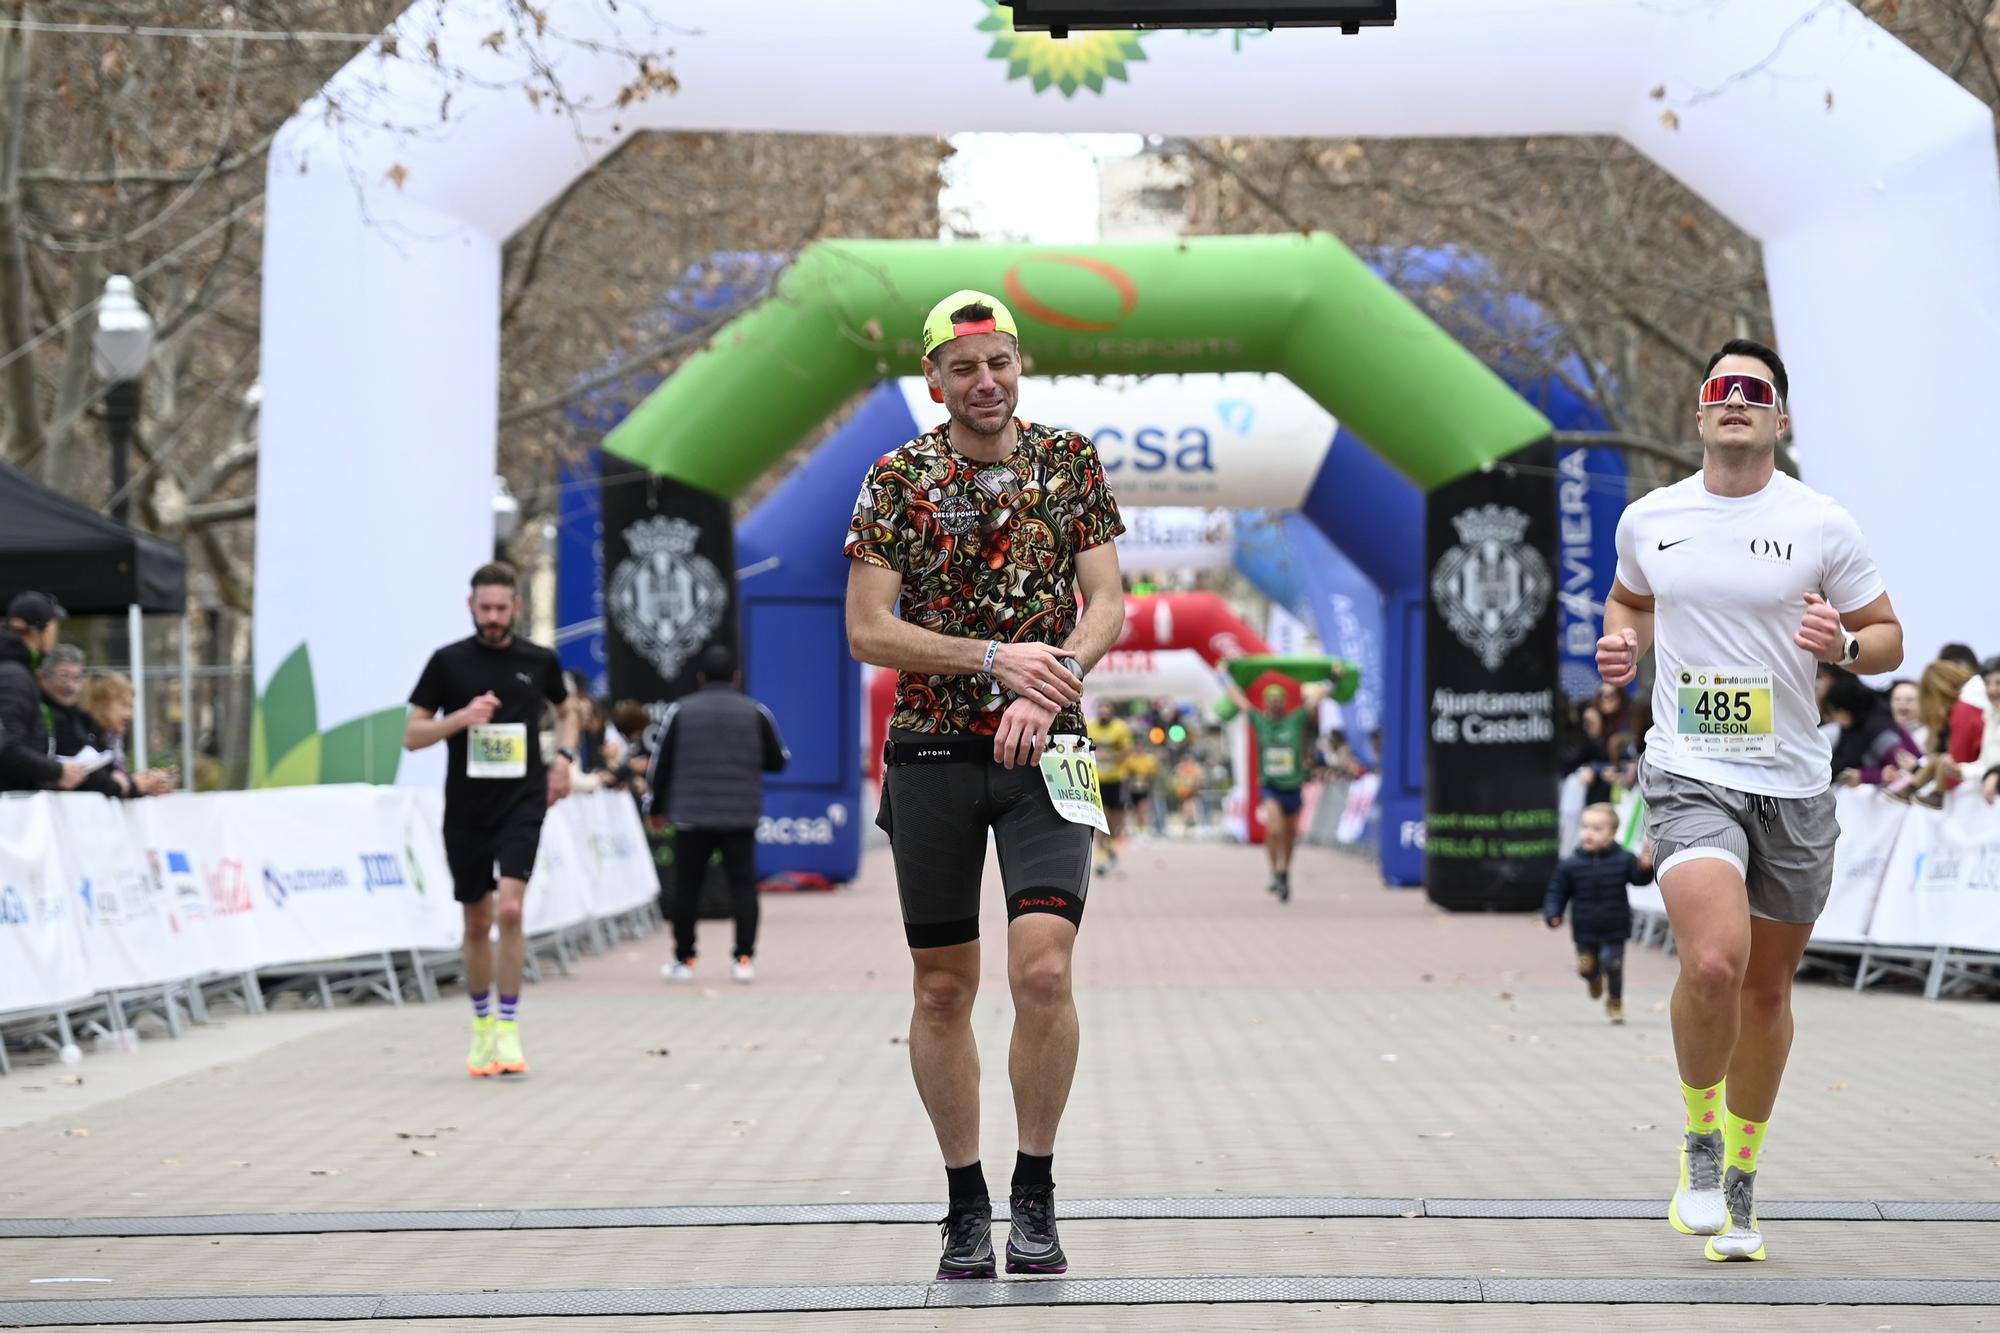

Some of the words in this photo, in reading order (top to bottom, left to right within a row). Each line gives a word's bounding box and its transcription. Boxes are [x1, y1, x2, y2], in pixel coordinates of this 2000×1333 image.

[957, 510, 980, 518] POWER
[1695, 690, 1752, 722] 485
[1699, 722, 1748, 734] OLESON
